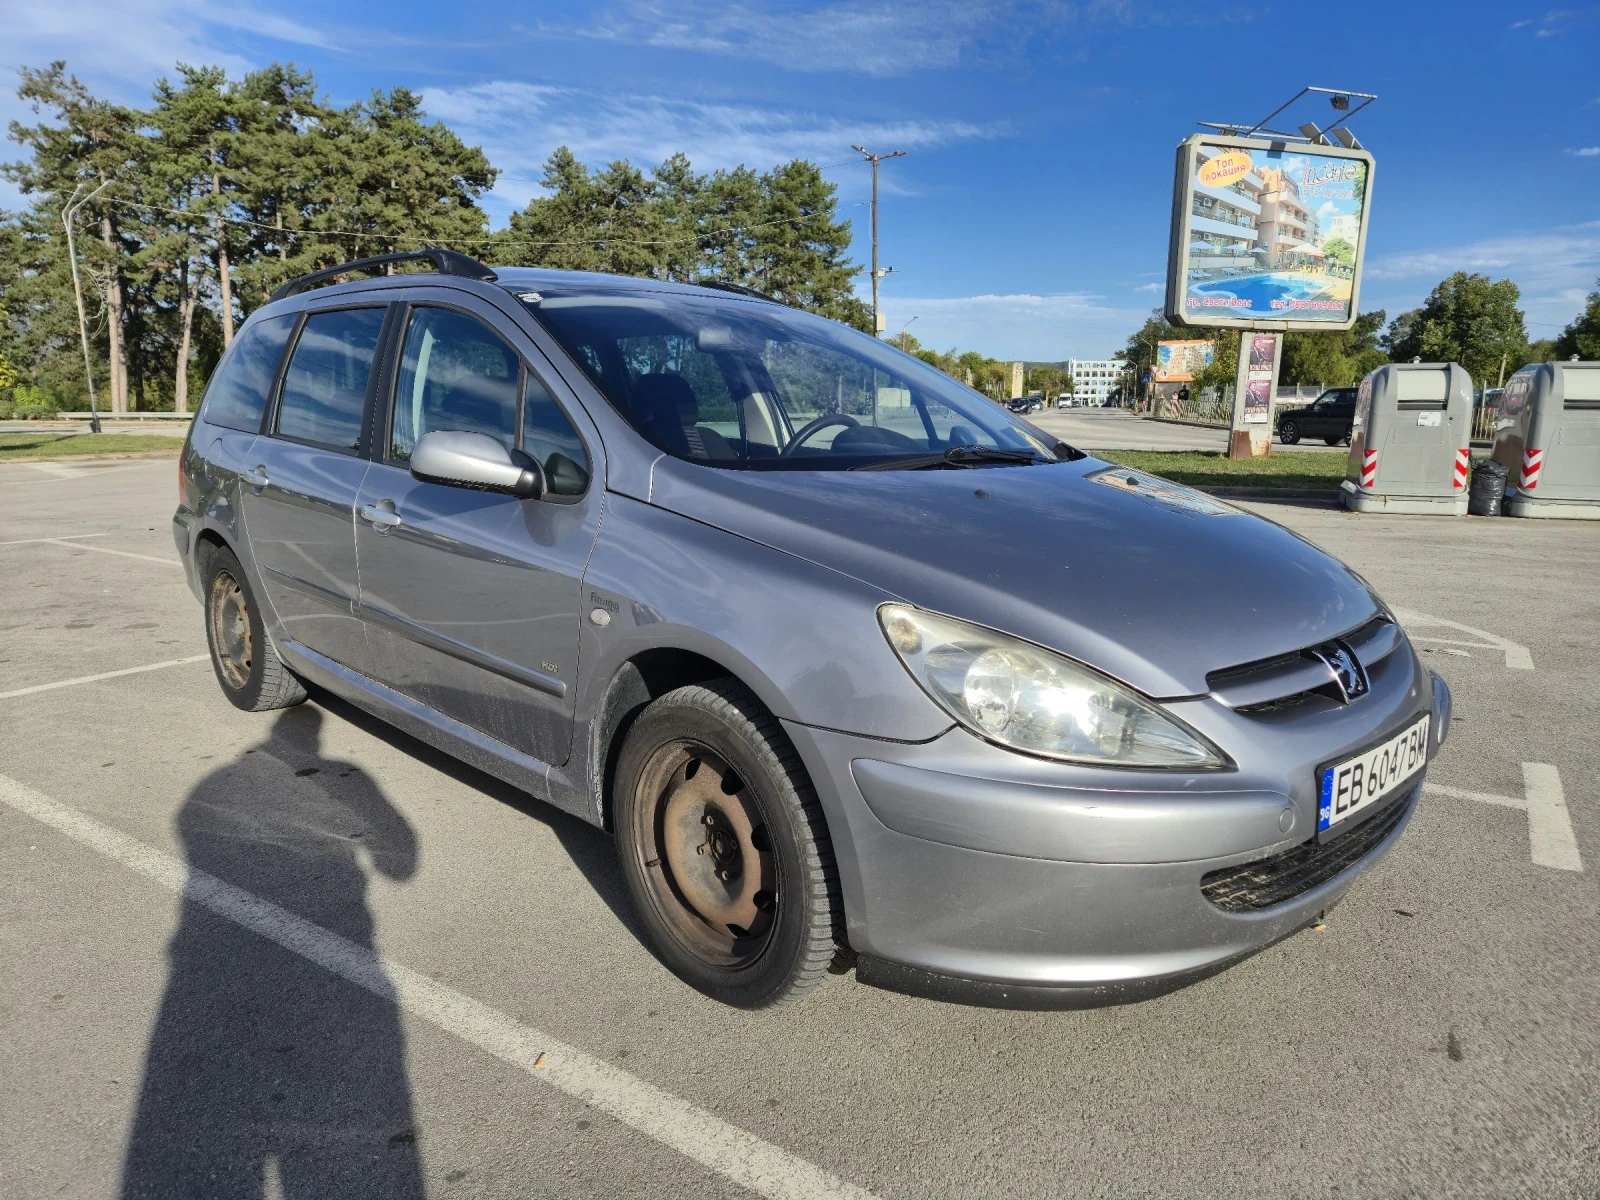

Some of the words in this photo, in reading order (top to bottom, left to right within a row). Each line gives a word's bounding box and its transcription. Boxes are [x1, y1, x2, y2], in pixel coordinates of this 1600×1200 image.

[1215, 158, 1233, 169] Топ
[1205, 165, 1246, 181] локация
[1203, 297, 1229, 307] Свети
[1231, 297, 1252, 307] Влас
[1335, 763, 1364, 815] EB
[1367, 737, 1408, 797] 6047
[1408, 722, 1427, 771] BM
